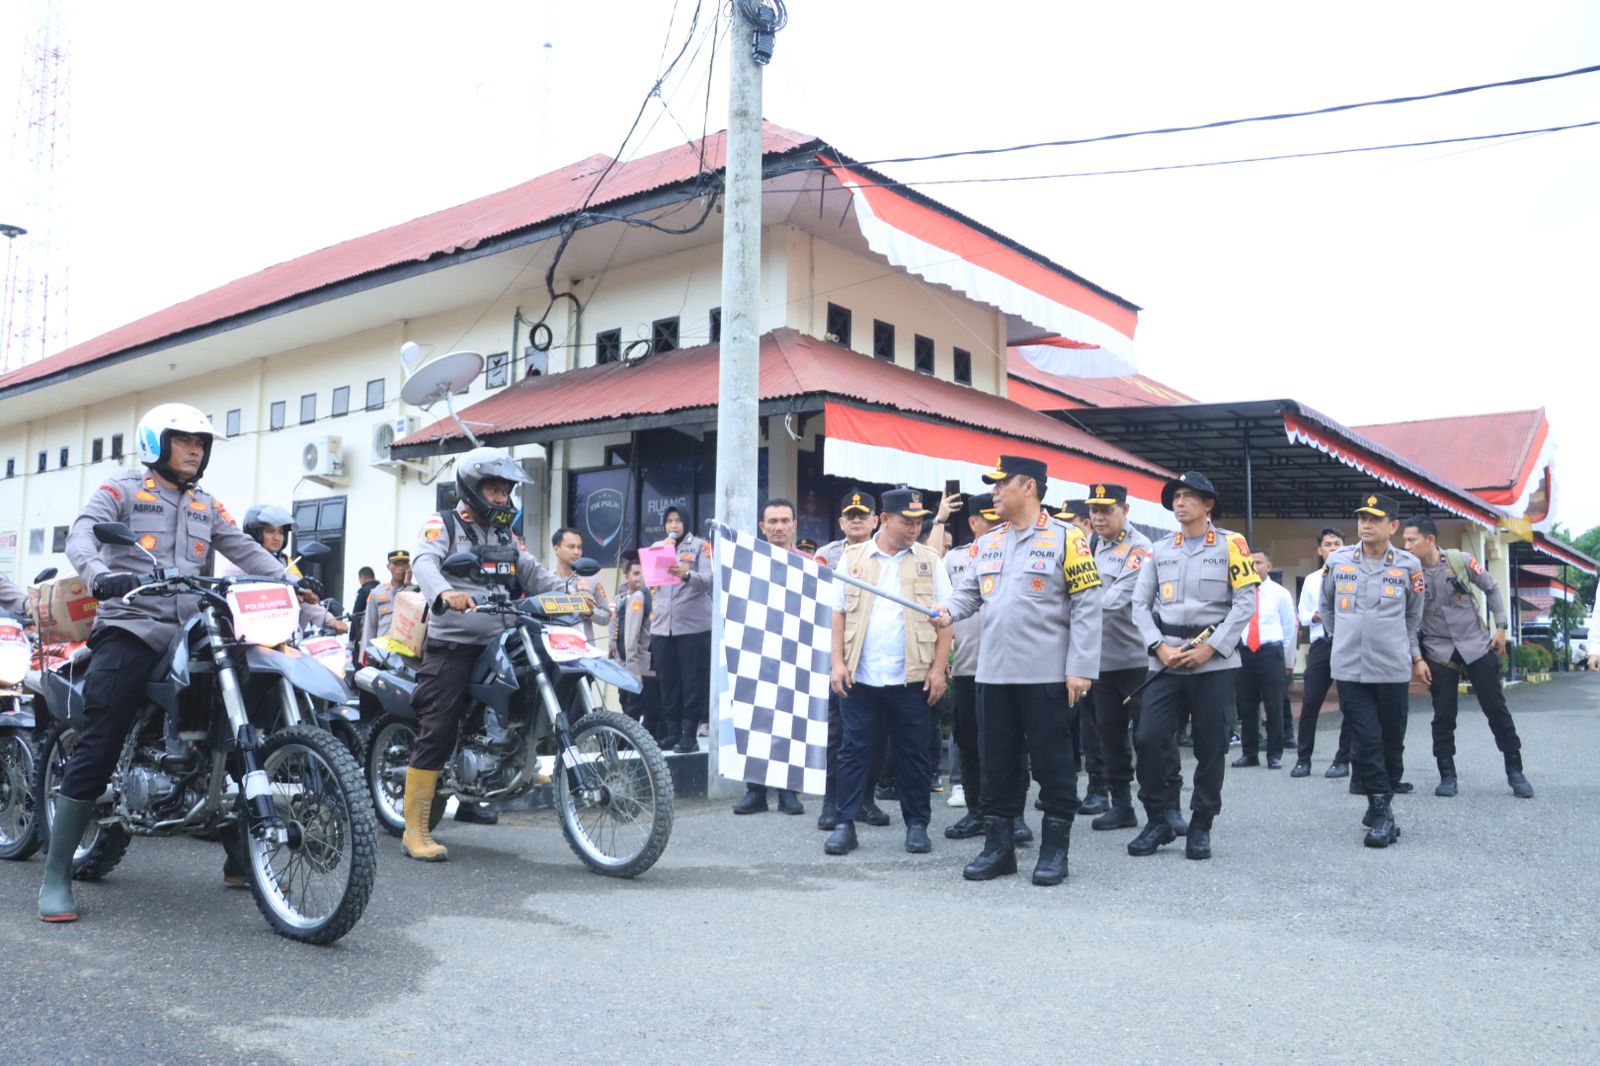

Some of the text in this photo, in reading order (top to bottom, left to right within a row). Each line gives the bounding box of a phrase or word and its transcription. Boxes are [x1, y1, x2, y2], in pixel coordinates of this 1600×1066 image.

[187, 511, 210, 522] POLRI
[982, 552, 1003, 560] DEDI
[1029, 551, 1055, 559] POLRI
[1203, 558, 1227, 566] POLRI
[1383, 577, 1406, 586] POLRI
